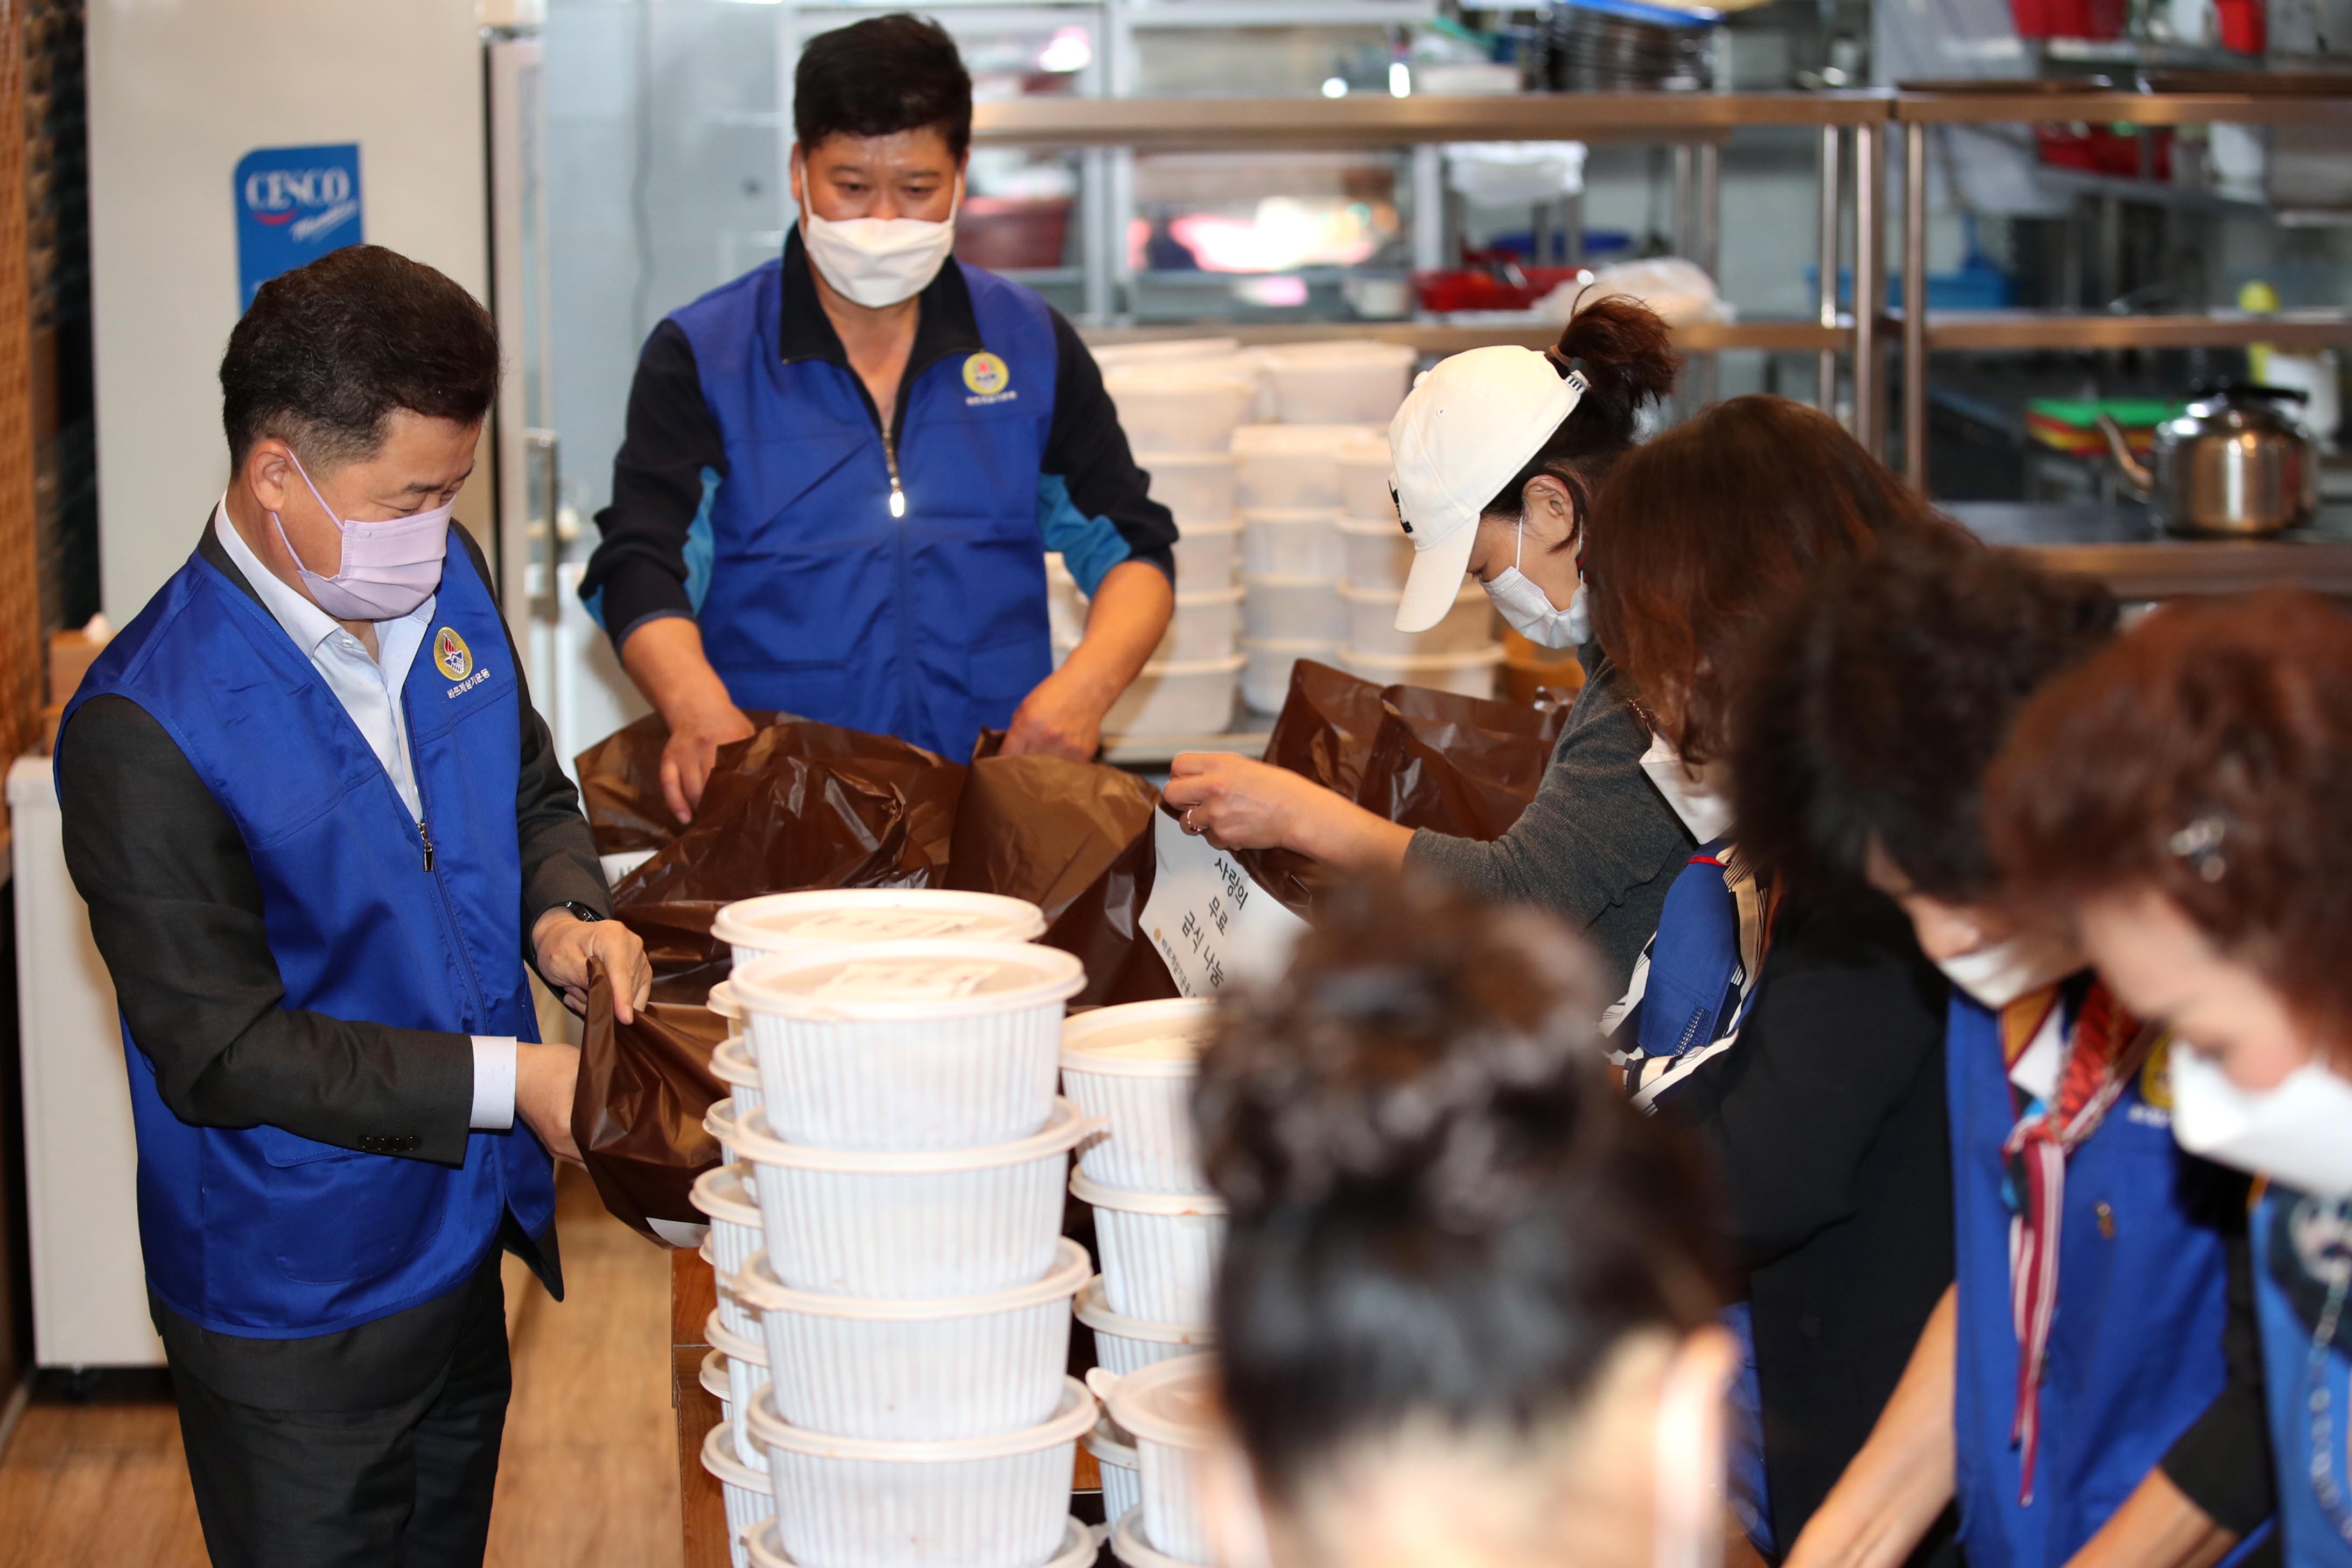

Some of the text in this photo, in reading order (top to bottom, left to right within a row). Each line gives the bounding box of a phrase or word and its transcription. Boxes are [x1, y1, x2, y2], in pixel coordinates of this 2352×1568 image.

[246, 167, 350, 210] CESCO
[447, 668, 490, 699] 바르게살기운동
[1214, 857, 1248, 910] 사랑의
[1209, 896, 1228, 936] 무료
[1161, 938, 1191, 996] 바르게살기운동
[1182, 910, 1224, 989] 급식 나눔
